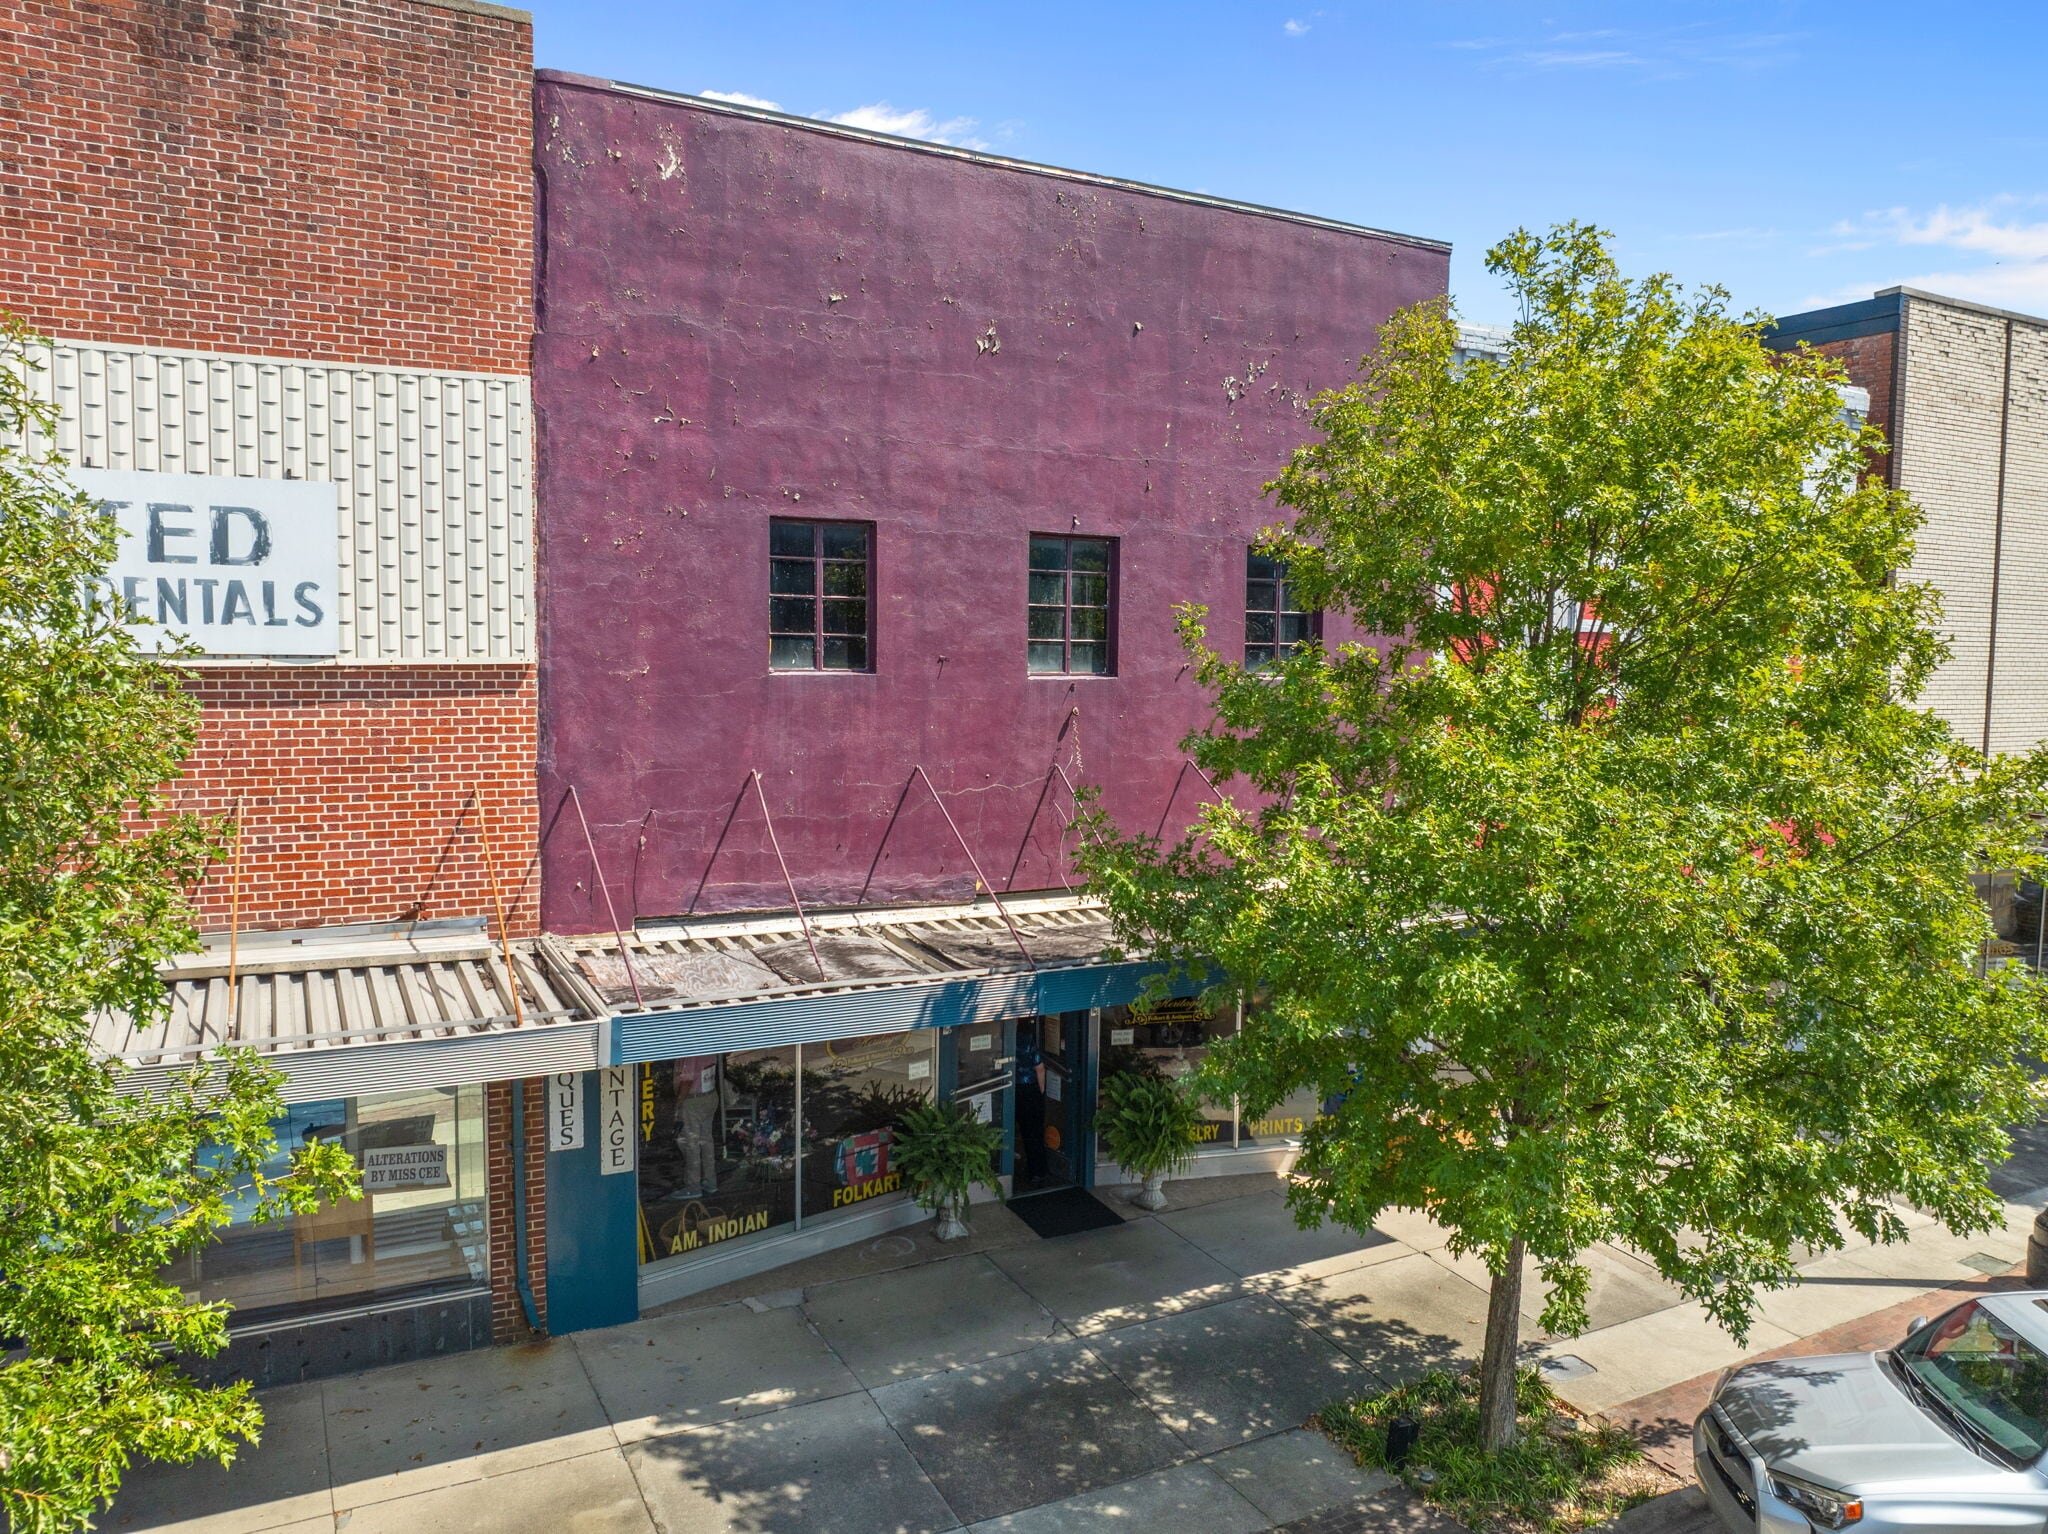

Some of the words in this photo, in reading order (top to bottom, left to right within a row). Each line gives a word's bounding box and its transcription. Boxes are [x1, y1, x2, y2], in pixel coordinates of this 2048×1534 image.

[57, 500, 273, 566] TED
[83, 576, 324, 627] RENTALS
[609, 1064, 626, 1167] NTAGE
[1250, 1117, 1304, 1135] PRINTS
[368, 1150, 444, 1166] ALTERATIONS
[371, 1170, 386, 1182] BY
[388, 1168, 416, 1180] MISS
[418, 1166, 440, 1179] CEE
[670, 1230, 703, 1254] AM.
[708, 1210, 768, 1243] INDIAN
